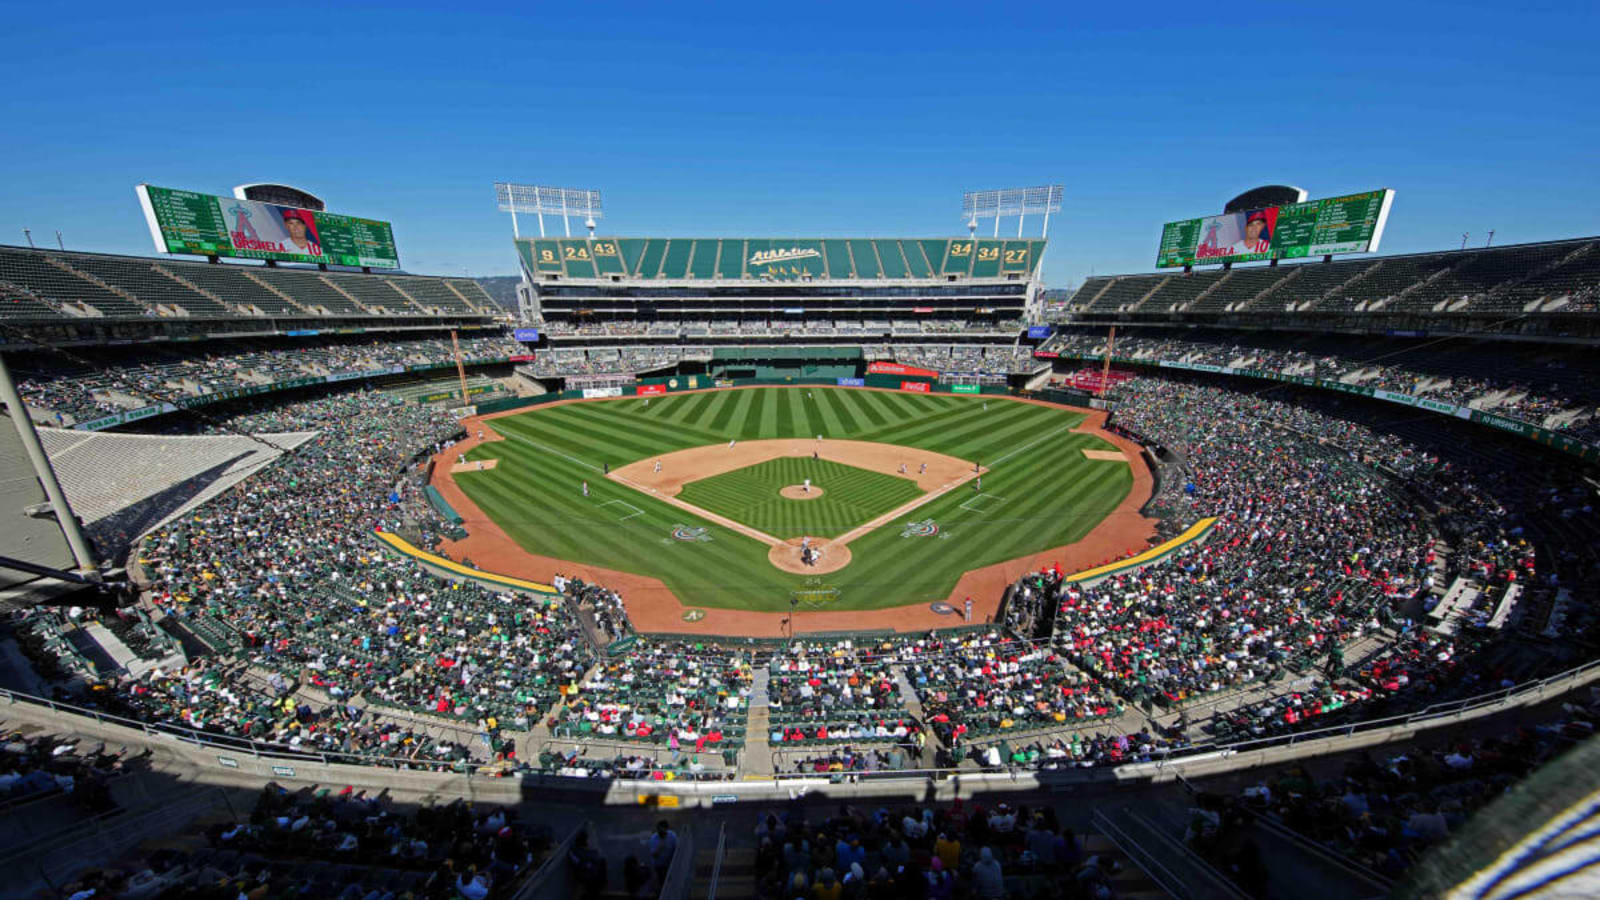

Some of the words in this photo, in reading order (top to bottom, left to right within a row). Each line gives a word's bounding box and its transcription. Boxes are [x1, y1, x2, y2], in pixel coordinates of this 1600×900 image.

[233, 238, 286, 252] URSHELA
[306, 242, 322, 257] 10
[594, 243, 616, 254] 43
[951, 243, 972, 255] 34
[1254, 239, 1269, 253] 10
[565, 247, 588, 259] 24
[749, 248, 821, 265] Athletics
[978, 247, 999, 259] 34
[1004, 250, 1027, 262] 27
